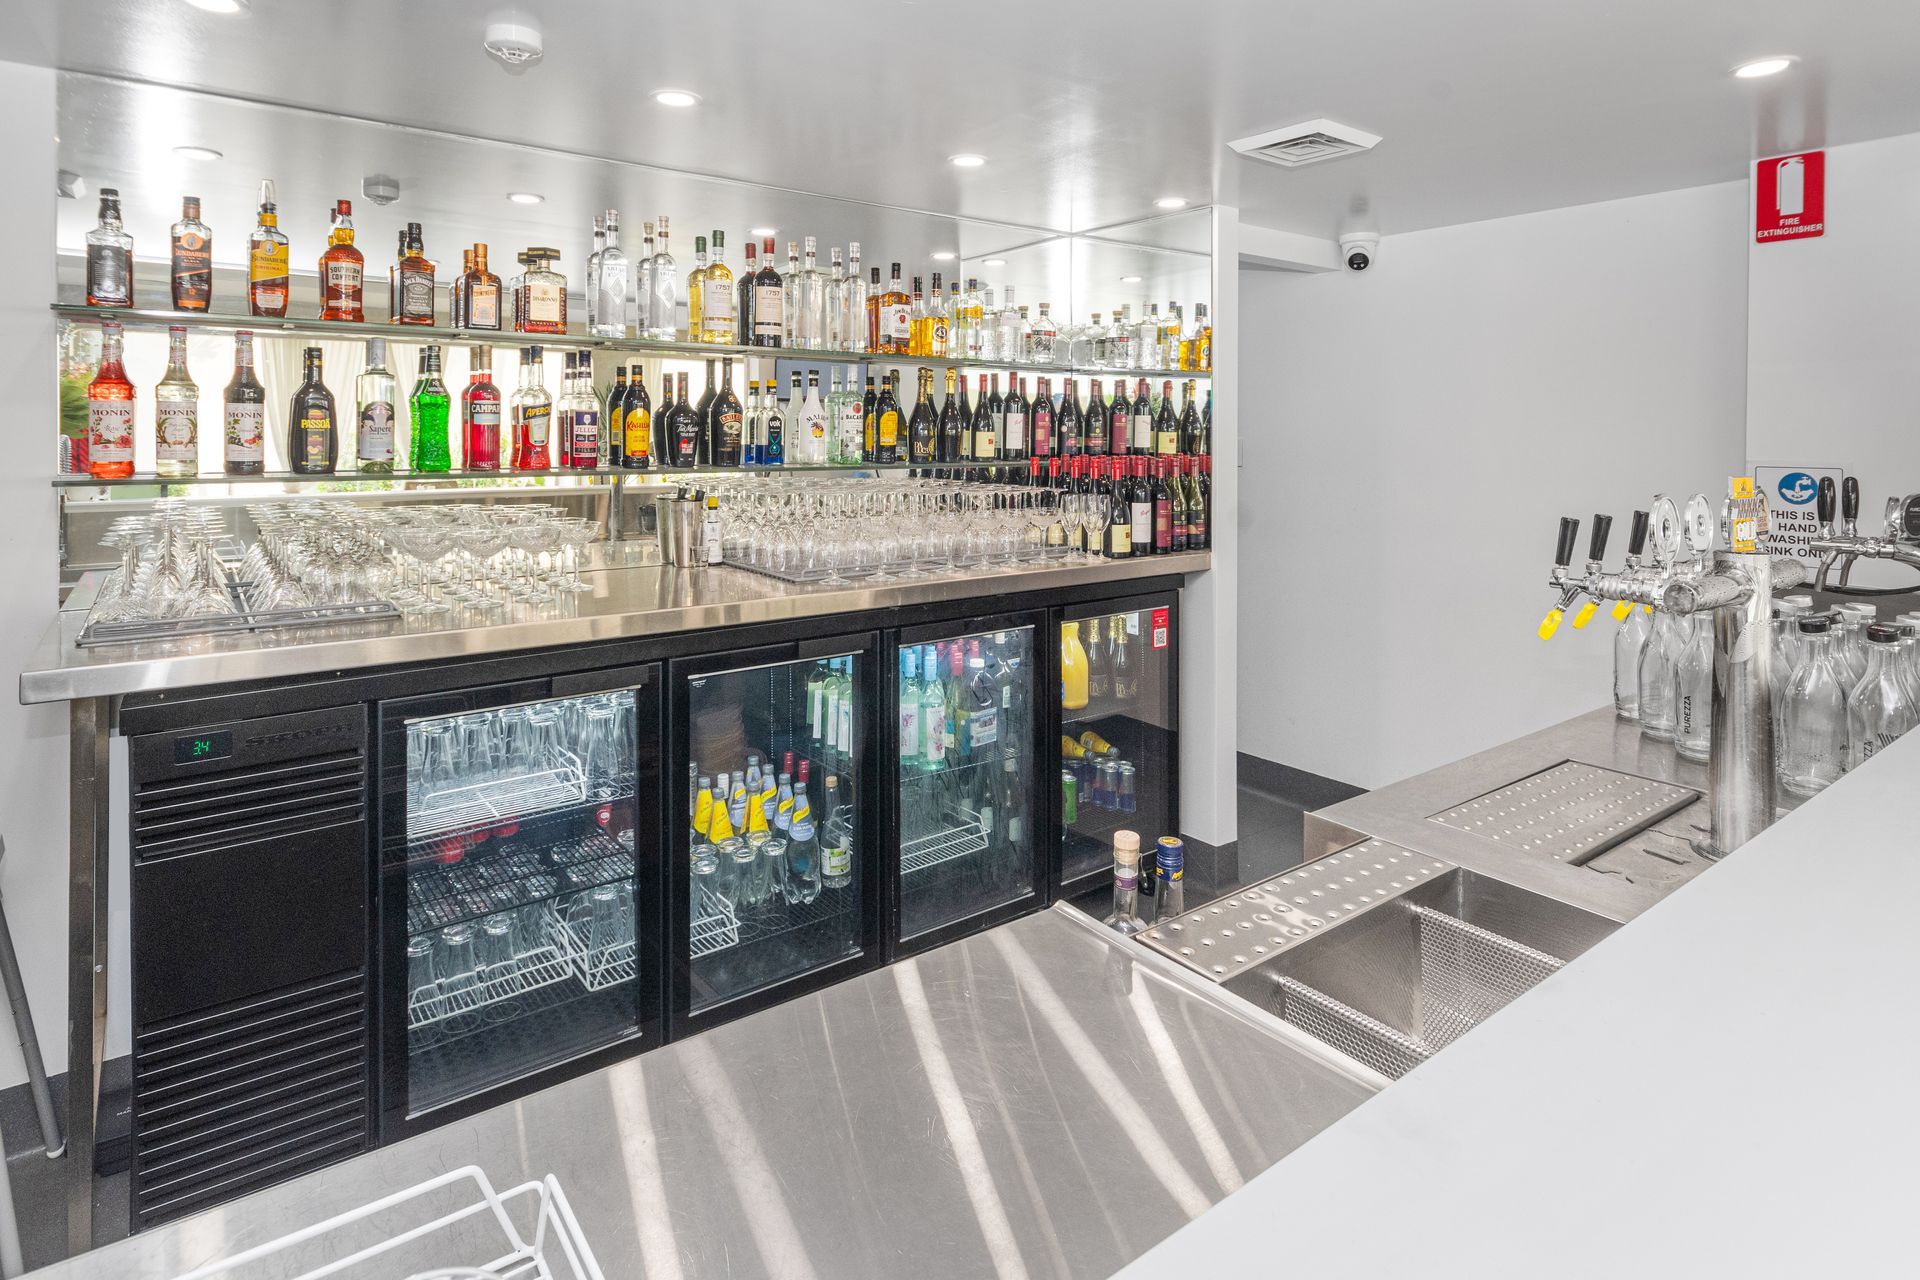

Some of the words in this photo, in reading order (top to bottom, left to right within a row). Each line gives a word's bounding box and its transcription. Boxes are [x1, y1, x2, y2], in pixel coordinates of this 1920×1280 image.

[1780, 217, 1800, 226] FIRE
[1757, 224, 1823, 238] EXTINGUISHER
[329, 265, 361, 275] SOUTHERN
[471, 403, 500, 413] CAMPAR
[525, 406, 550, 418] APERO
[228, 411, 263, 419] MONIN
[845, 413, 864, 421] BACAR
[369, 424, 392, 435] Sapere
[1771, 510, 1798, 520] THIS
[1803, 512, 1815, 521] IS
[1779, 522, 1817, 533] HAND
[1768, 534, 1814, 546] WASHI
[1797, 548, 1824, 558] ONL
[1683, 695, 1692, 734] PUREZZA
